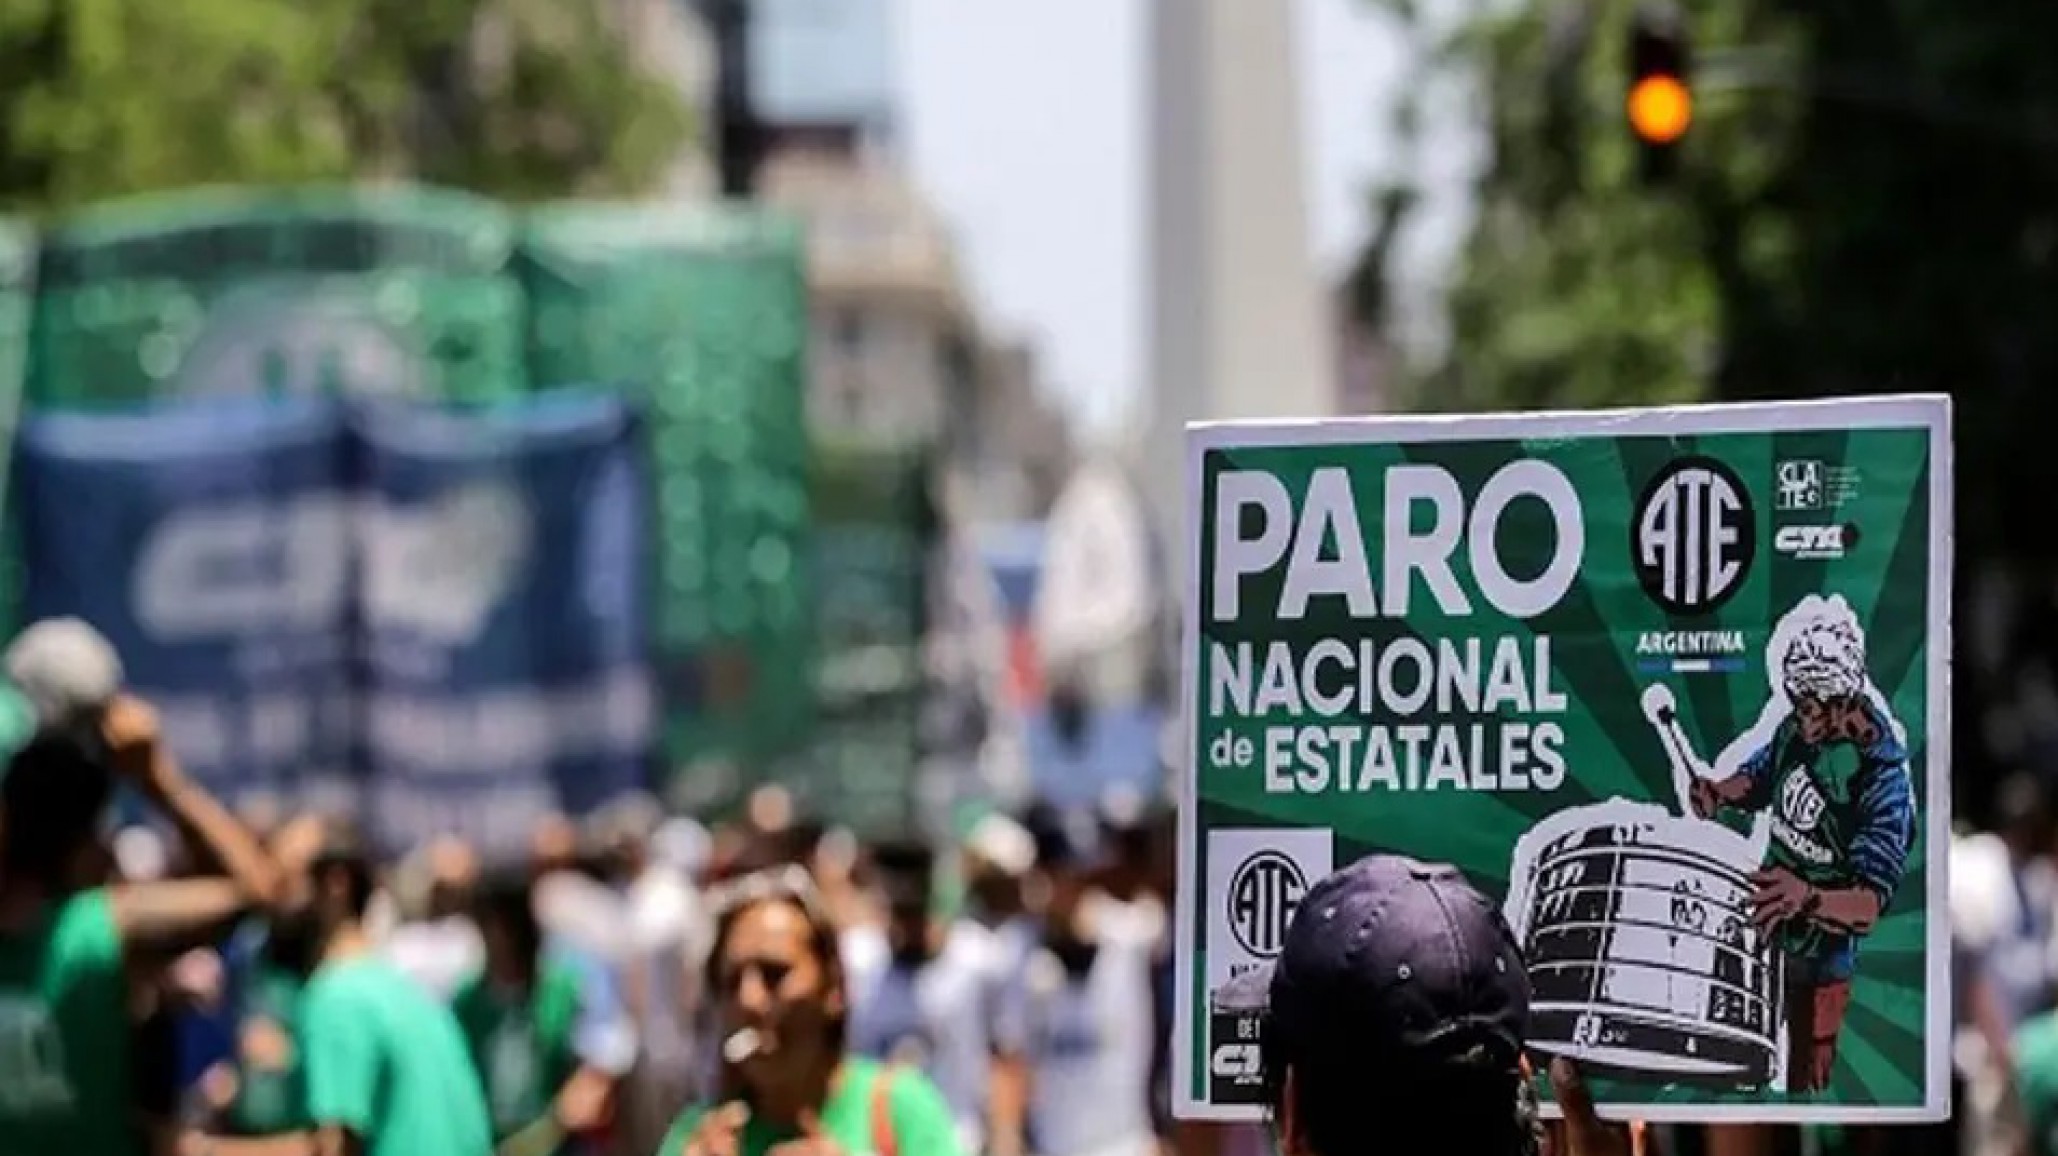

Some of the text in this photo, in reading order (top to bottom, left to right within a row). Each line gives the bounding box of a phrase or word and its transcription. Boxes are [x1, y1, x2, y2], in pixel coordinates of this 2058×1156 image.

[1213, 459, 1584, 621] PARO
[1640, 469, 1743, 605] ATE
[1210, 635, 1567, 717] NACIONAL
[1636, 630, 1746, 654] ARGENTINA
[1209, 722, 1566, 793] de ESTATALES
